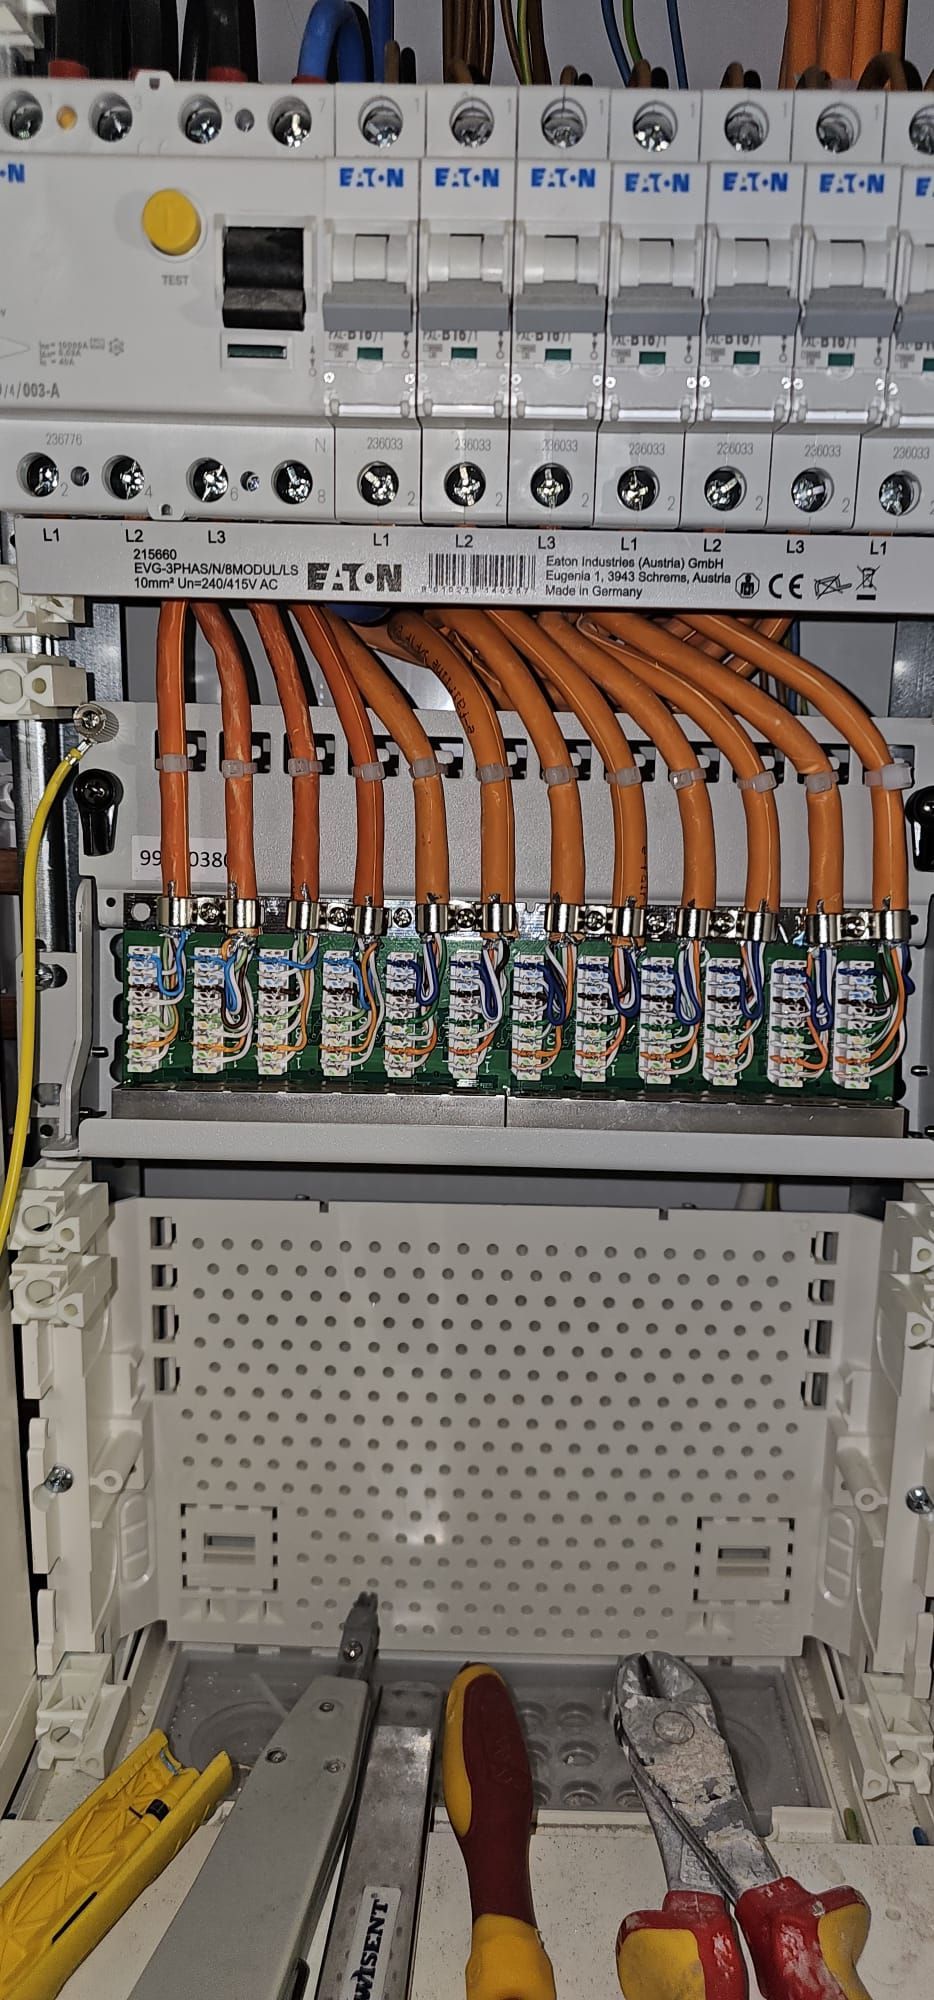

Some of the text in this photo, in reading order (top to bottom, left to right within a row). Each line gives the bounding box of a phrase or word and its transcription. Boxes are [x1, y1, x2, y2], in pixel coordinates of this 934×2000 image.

[162, 275, 188, 286] TEST
[0, 380, 60, 399] /4/003-A
[46, 433, 82, 446] 236776
[315, 438, 326, 453] N
[367, 437, 403, 450] 236033
[61, 483, 69, 497] 2
[230, 487, 239, 501] 6
[317, 489, 326, 503] 8
[408, 491, 415, 506] 2
[495, 493, 503, 507] 2
[581, 494, 589, 508] 2
[667, 497, 675, 511] 2
[755, 497, 763, 511] 2
[842, 498, 850, 512] 2
[43, 528, 60, 542] L1
[125, 529, 144, 543] L2
[208, 530, 226, 544] L3
[373, 533, 389, 547] L1
[455, 534, 473, 548] L2
[538, 536, 556, 550] L3
[621, 537, 637, 551] L1
[704, 538, 722, 552] L2
[786, 540, 804, 554] L3
[870, 541, 887, 555] L1
[133, 549, 177, 560] 215660
[134, 562, 299, 576] EVG-3PHAS/N/8MODUL/LS
[546, 555, 724, 571] Eaton Industries (Austria) GmbH
[178, 578, 257, 590] Un=240/415V
[261, 579, 278, 590] AC
[307, 562, 402, 592] EATON
[546, 571, 731, 584] Eugenia 1, 3943 Schrems, Austria
[545, 585, 643, 599] Made in Germany
[768, 573, 804, 599] CE
[140, 849, 228, 868] 99038
[350, 1898, 389, 2000] WISENT
